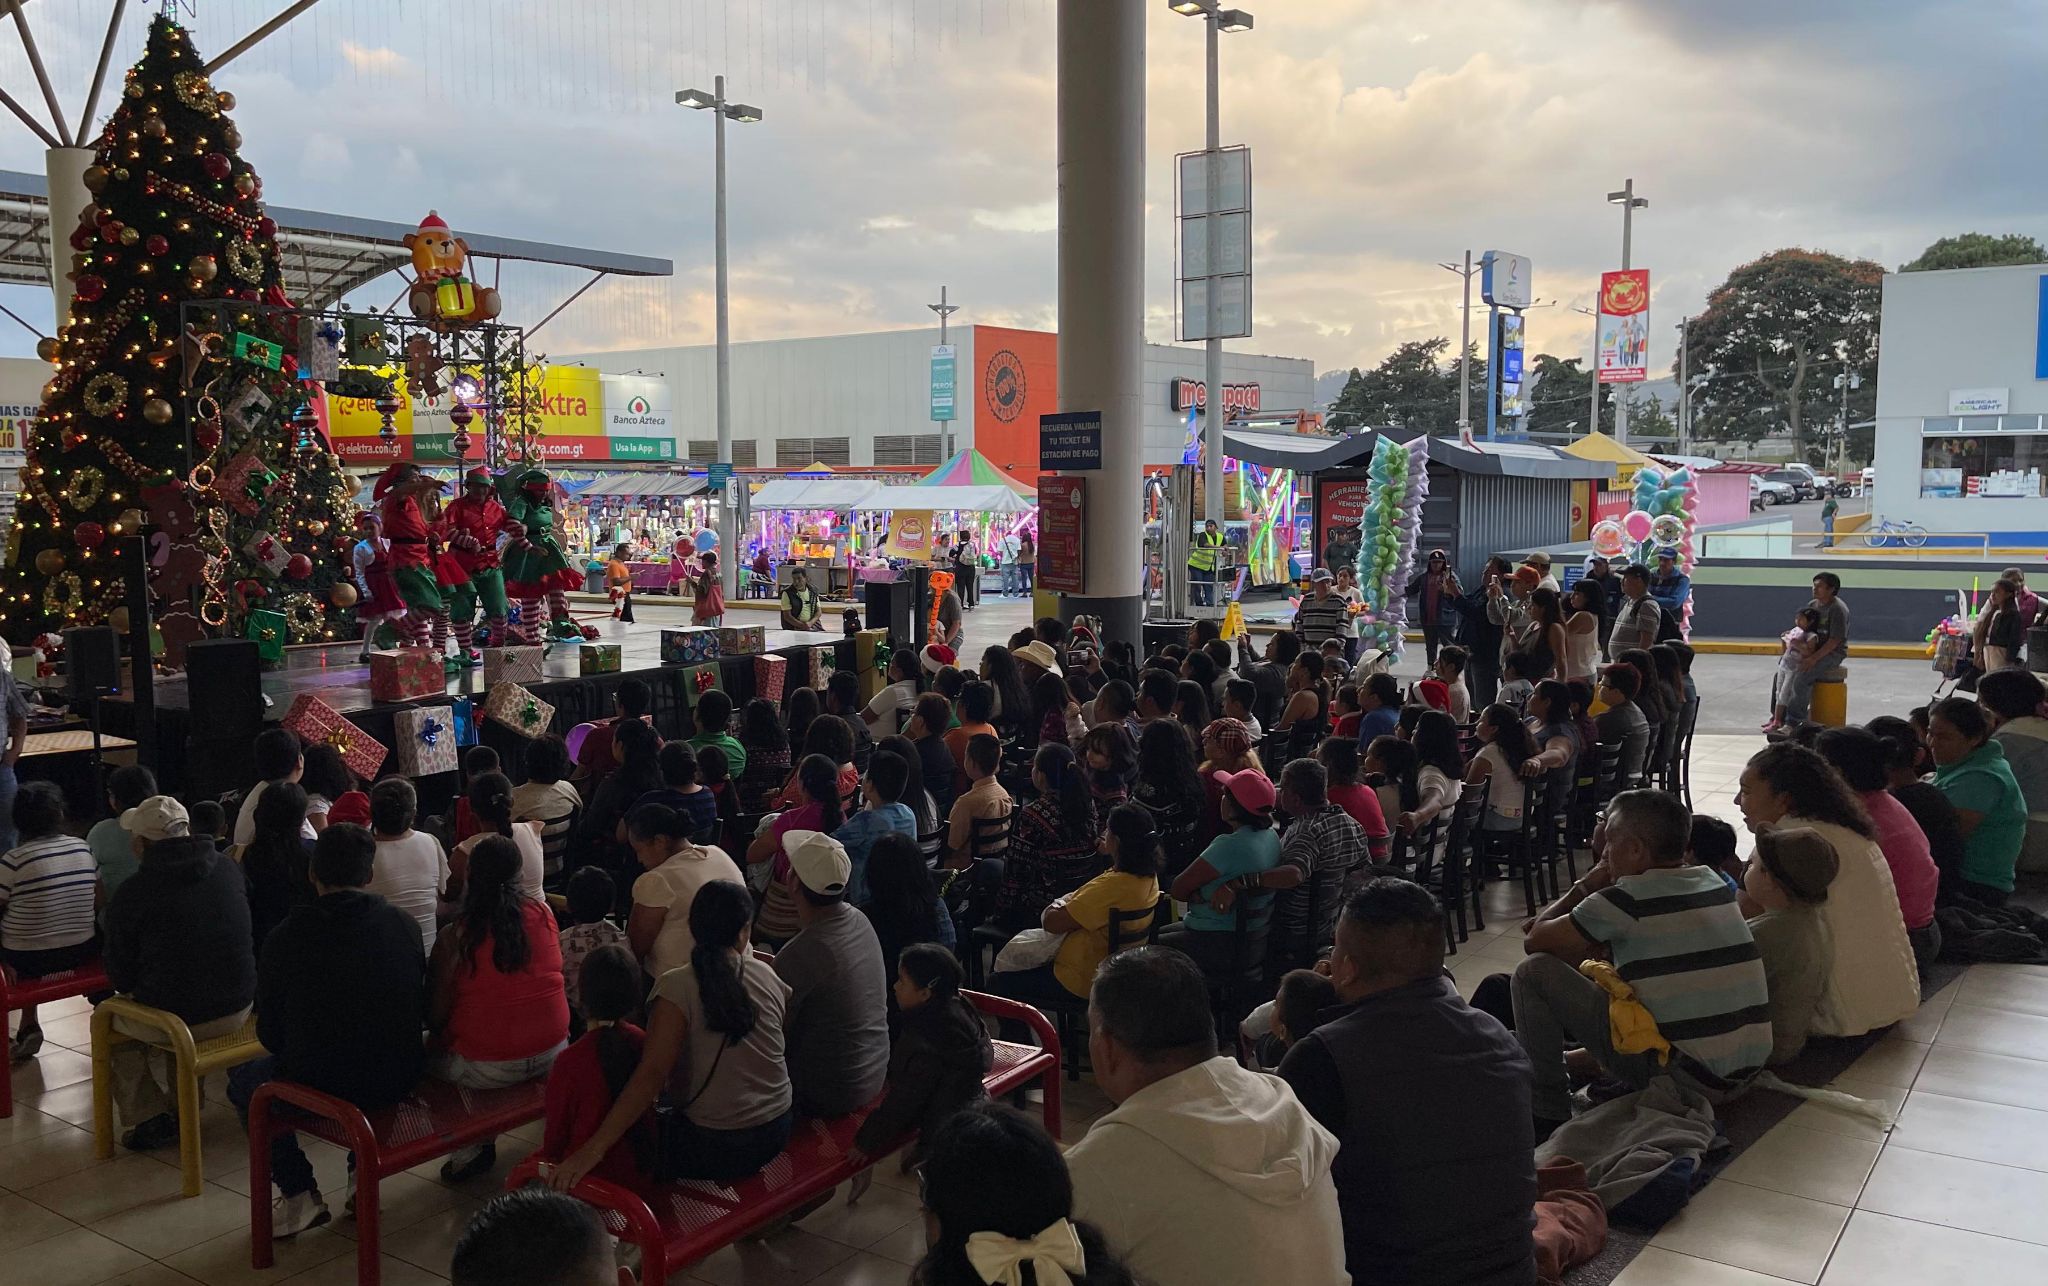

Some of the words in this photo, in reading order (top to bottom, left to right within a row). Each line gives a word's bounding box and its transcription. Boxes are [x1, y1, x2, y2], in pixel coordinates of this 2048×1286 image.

[1954, 403, 2002, 412] ECOLIGHT
[613, 415, 638, 424] Banco
[640, 416, 665, 425] Azteca
[1041, 424, 1072, 432] RECUERDA
[1074, 421, 1100, 430] VALIDAR
[1049, 437, 1057, 445] TU
[1059, 436, 1080, 445] TICKET
[1082, 436, 1090, 444] EN
[615, 443, 628, 452] Usa
[630, 443, 636, 452] la
[637, 443, 653, 455] App
[1073, 449, 1081, 458] DE
[1082, 449, 1099, 458] PAGO
